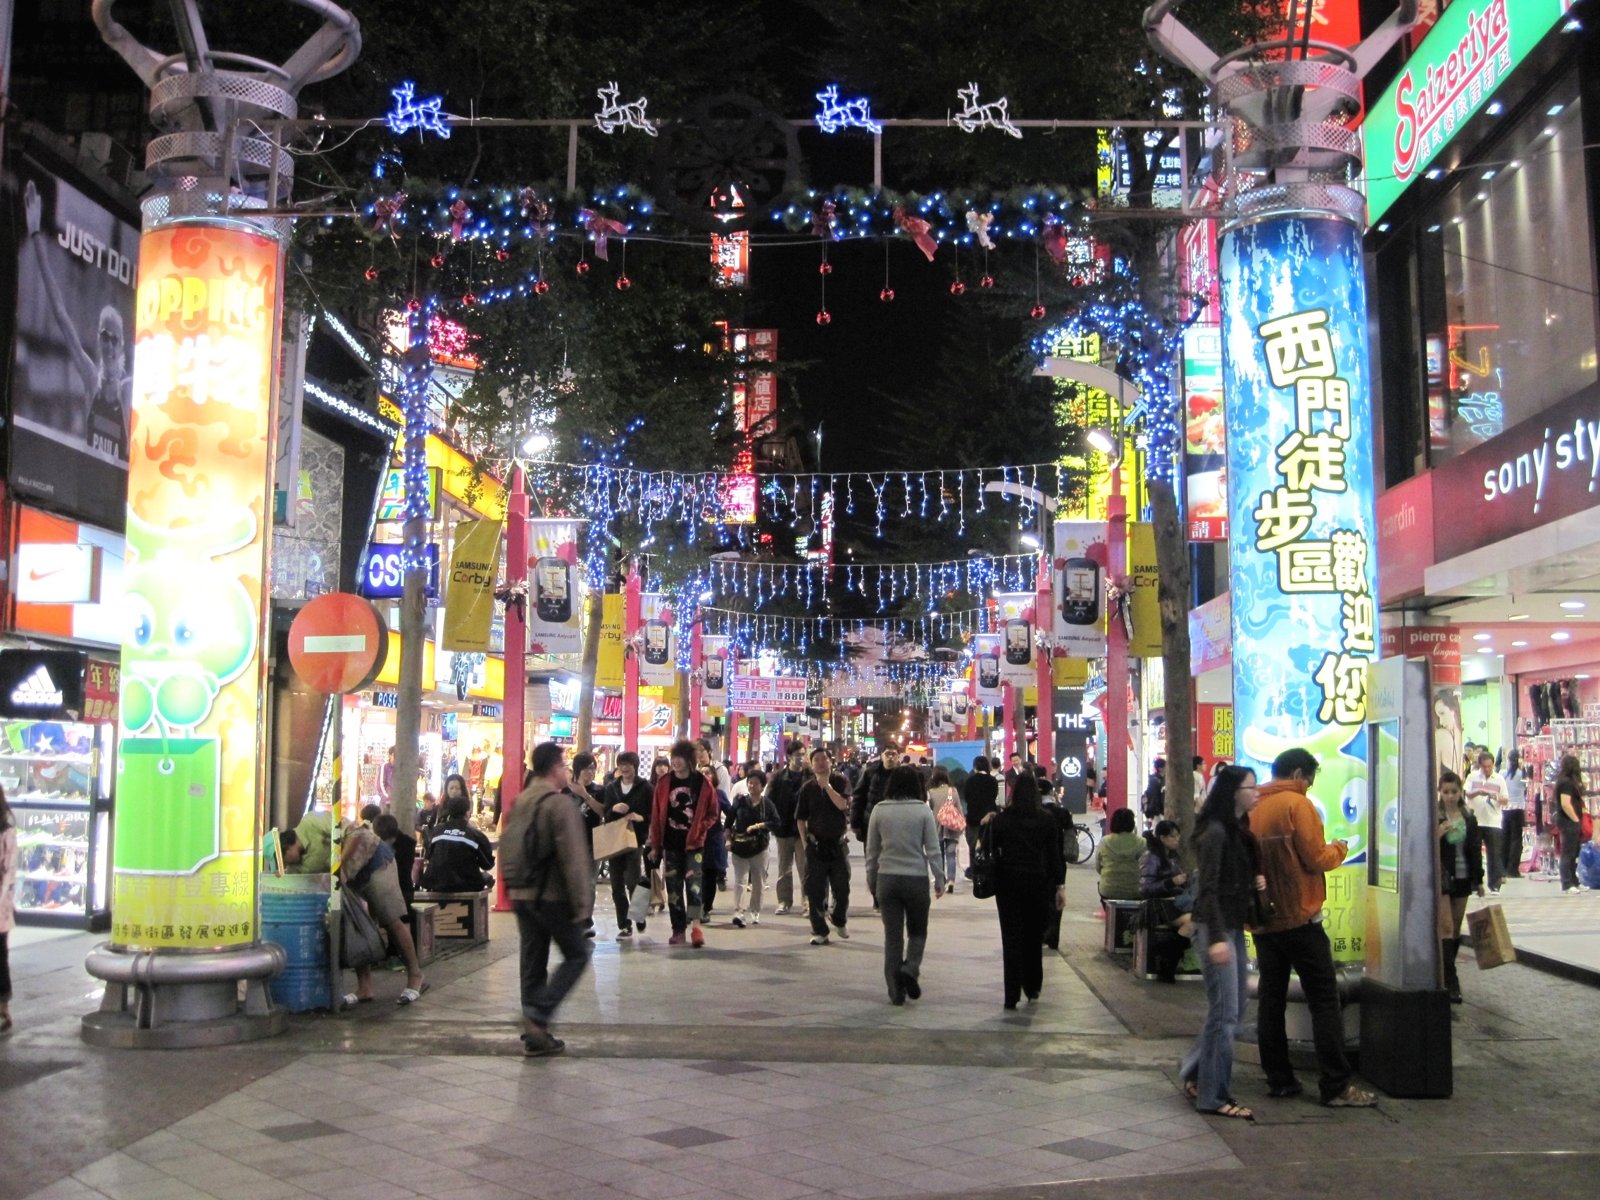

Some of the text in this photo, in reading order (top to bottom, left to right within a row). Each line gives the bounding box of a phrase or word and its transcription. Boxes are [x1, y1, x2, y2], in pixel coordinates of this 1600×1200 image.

[1394, 0, 1508, 181] Saizeriya
[58, 222, 106, 269] JUST
[107, 251, 131, 285] DO
[1255, 309, 1350, 593] 西門徒步區
[1484, 428, 1550, 513] sony
[453, 571, 491, 588] Corby
[455, 561, 492, 571] SAMSUNG
[1317, 531, 1374, 725] 歡迎您
[1410, 632, 1447, 644] pierre
[1055, 713, 1086, 728] THE
